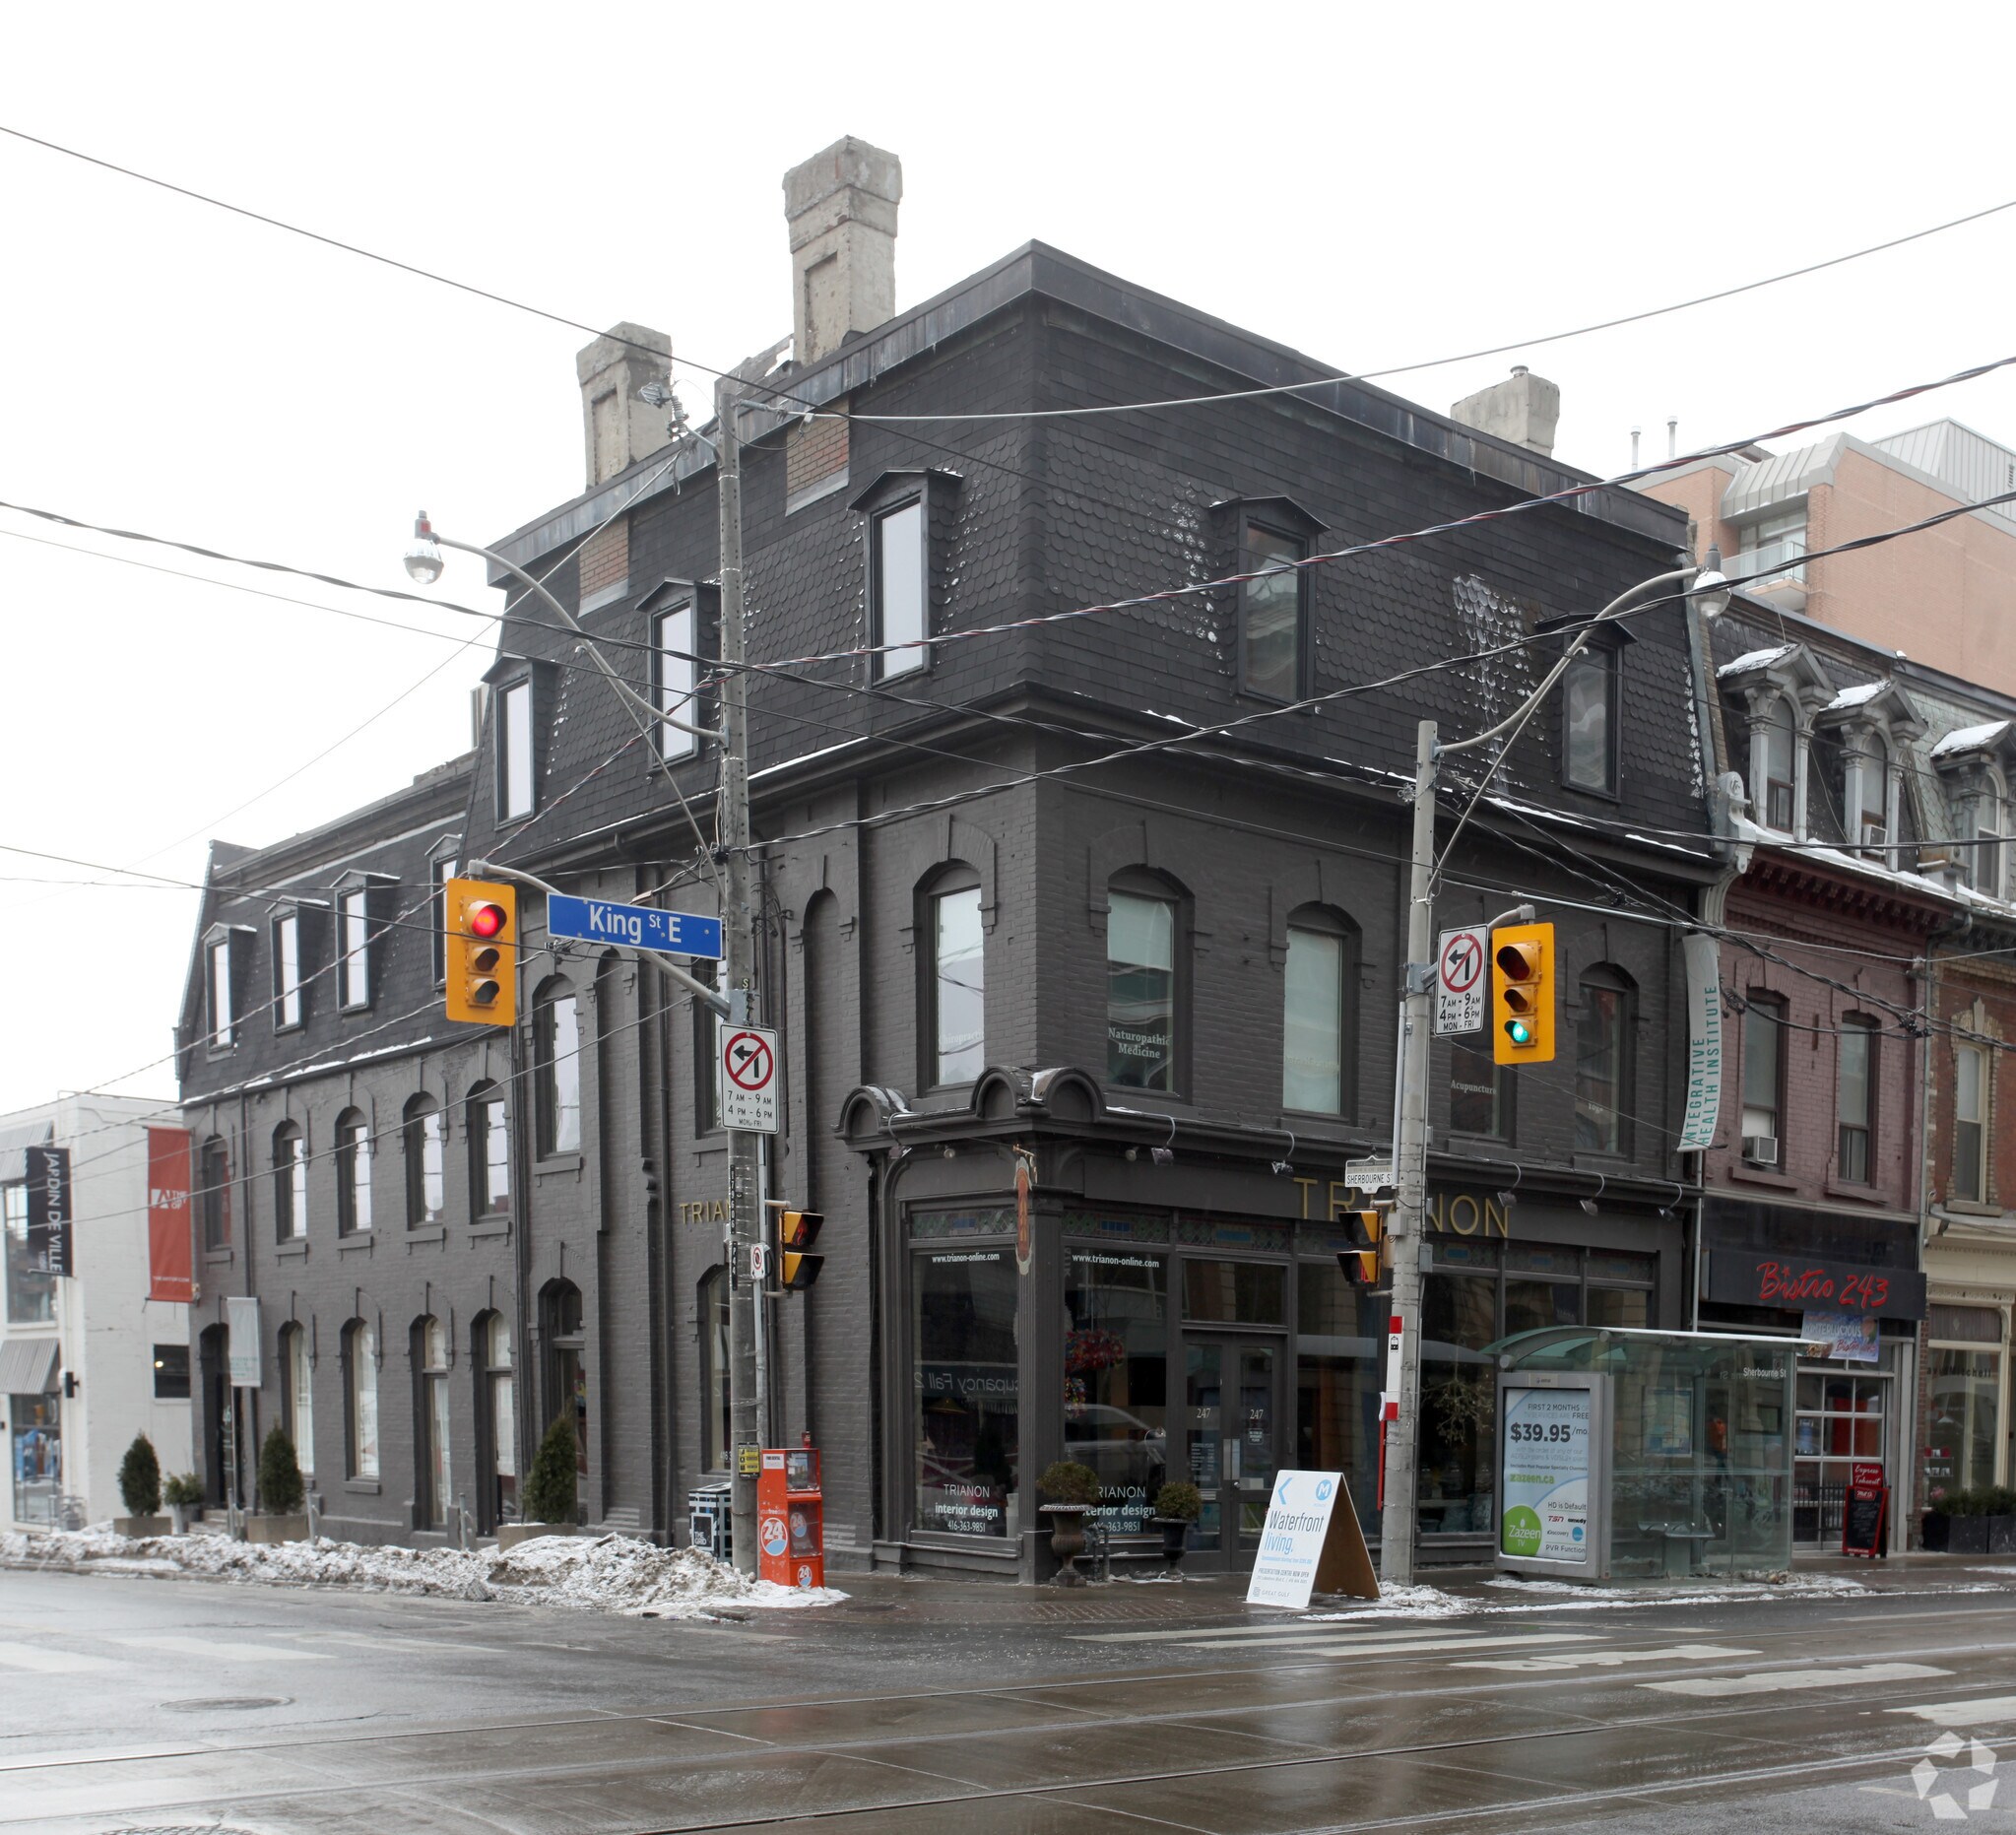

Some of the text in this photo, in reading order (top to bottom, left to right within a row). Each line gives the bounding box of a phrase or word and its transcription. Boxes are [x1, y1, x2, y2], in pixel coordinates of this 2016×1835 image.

[590, 904, 682, 945] King St E
[1441, 996, 1447, 1008] 7
[1464, 993, 1470, 1006] 9
[1440, 1010, 1447, 1020] 4
[1464, 1008, 1469, 1019] 6
[1443, 1022, 1458, 1031] MON
[1464, 1020, 1474, 1029] FRI
[1108, 1027, 1171, 1045] Naturopathic
[1118, 1043, 1160, 1058] Medicine
[1699, 986, 1720, 1145] HEALTH INSTITUTE
[1451, 1080, 1497, 1095] Acupuncture
[1683, 1038, 1705, 1147] INTEGRATIVE
[728, 1090, 733, 1100] 7
[755, 1093, 760, 1104] 9
[763, 1096, 772, 1105] AM
[728, 1104, 734, 1114] 4
[756, 1108, 761, 1118] 6
[763, 1110, 772, 1119] PM
[1347, 1173, 1385, 1184] SHERBOURNE
[43, 1150, 63, 1272] JARDIN DE VILLE
[932, 1253, 1000, 1264] www.trianon-online.com
[1073, 1253, 1159, 1268] www.trianon-online.com
[1756, 1262, 1889, 1309] Bistro 243
[1743, 1367, 1787, 1378] Sherbourne St
[1197, 1409, 1210, 1418] 247
[1250, 1409, 1264, 1419] 247
[1510, 1422, 1590, 1443] $39.95 /mo.
[1510, 1474, 1554, 1484] zazeen.ca
[943, 1484, 990, 1498] TRIANON
[1097, 1486, 1146, 1498] RIANON
[1318, 1484, 1331, 1497] M
[935, 1502, 999, 1520] interior design
[1121, 1504, 1156, 1519] design
[791, 1515, 804, 1527] 24
[947, 1521, 986, 1533] 416-363-9851
[1268, 1510, 1325, 1533] Waterfront
[763, 1521, 784, 1540] 24
[1509, 1525, 1541, 1539] Zazeen
[1264, 1533, 1293, 1554] living.
[800, 1567, 810, 1578] 24
